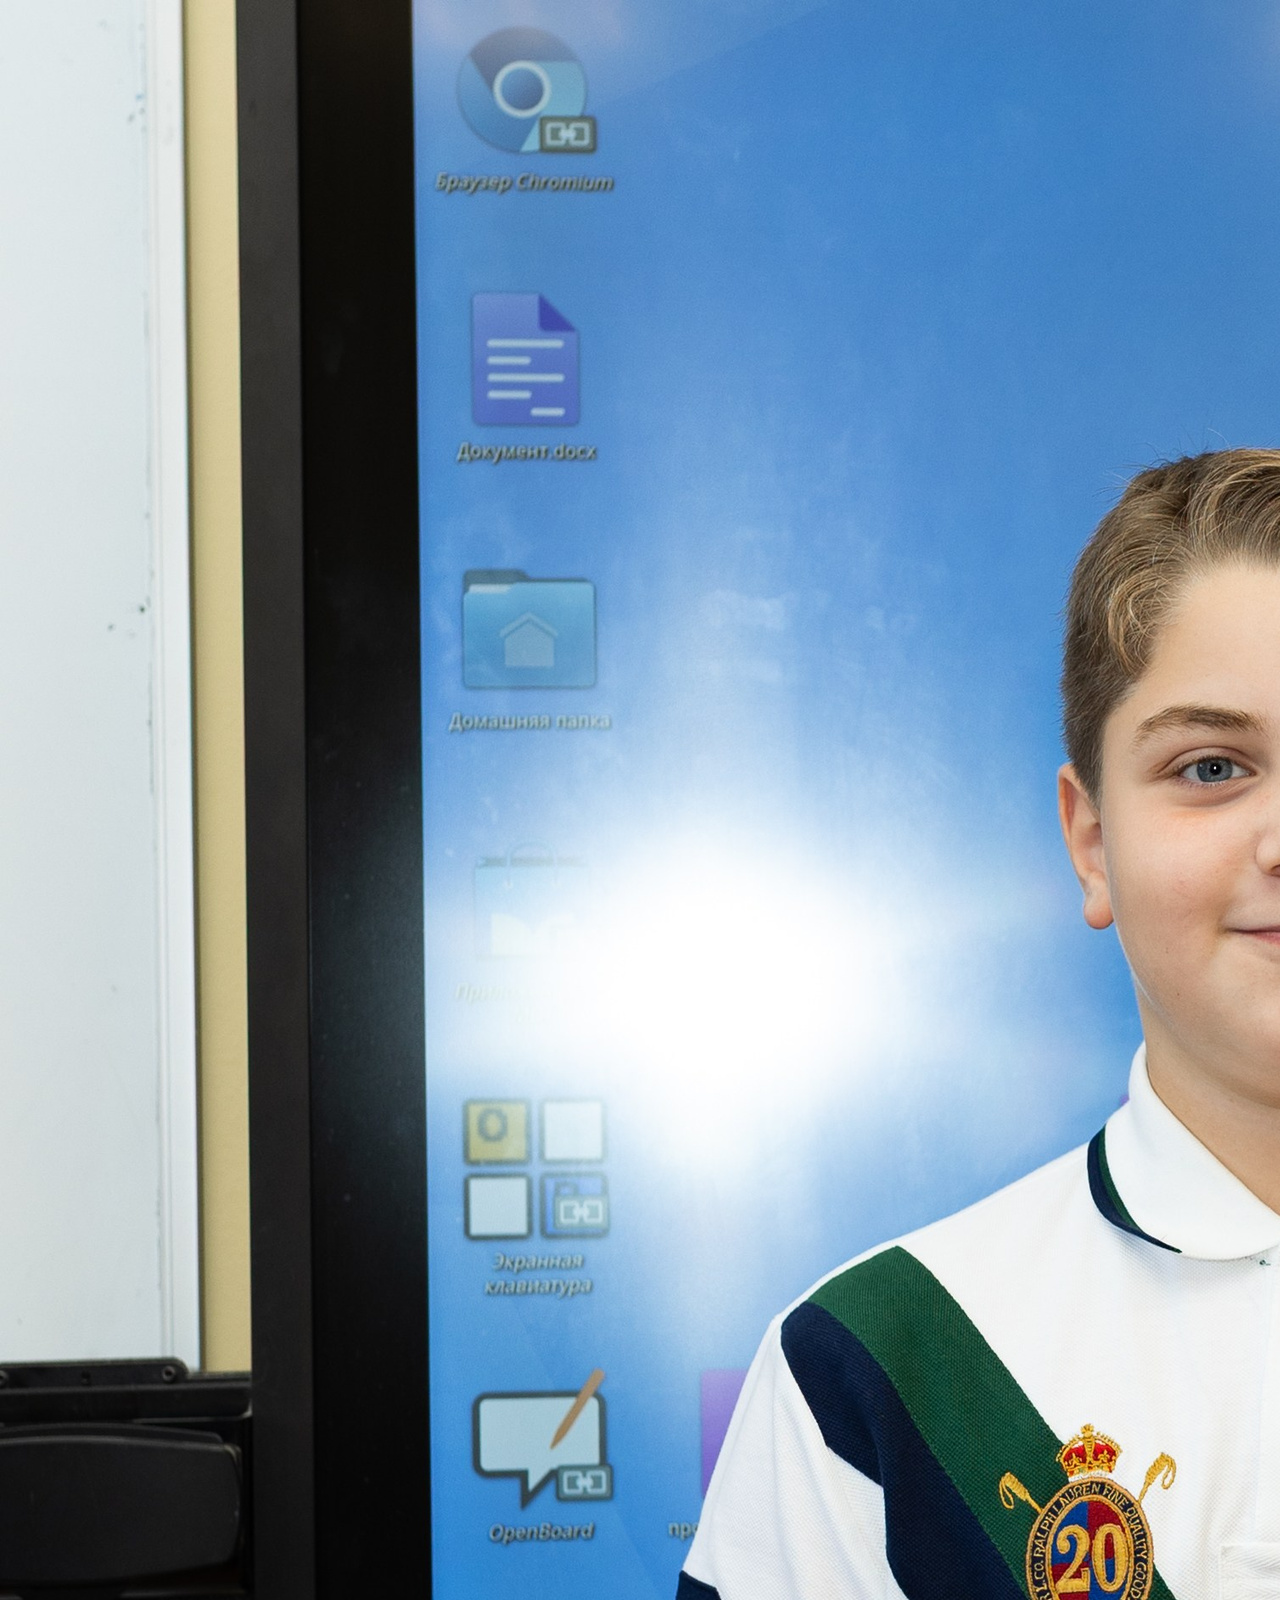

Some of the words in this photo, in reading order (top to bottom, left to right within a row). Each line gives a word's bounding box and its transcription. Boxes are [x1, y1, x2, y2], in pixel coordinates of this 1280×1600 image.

[436, 172, 512, 194] Браузер
[517, 173, 614, 192] Chromium
[456, 441, 597, 464] Документ.docx
[449, 711, 550, 732] Домашняя
[556, 713, 612, 731] папка
[492, 1252, 584, 1274] Экранная
[484, 1277, 593, 1297] клавиатура
[1033, 1512, 1057, 1557] RALPH
[1052, 1482, 1101, 1514] LAUREN
[1102, 1483, 1129, 1510] FINE
[1124, 1507, 1148, 1559] QUALITY
[489, 1522, 595, 1544] OpenBoard
[1055, 1523, 1129, 1594] 20
